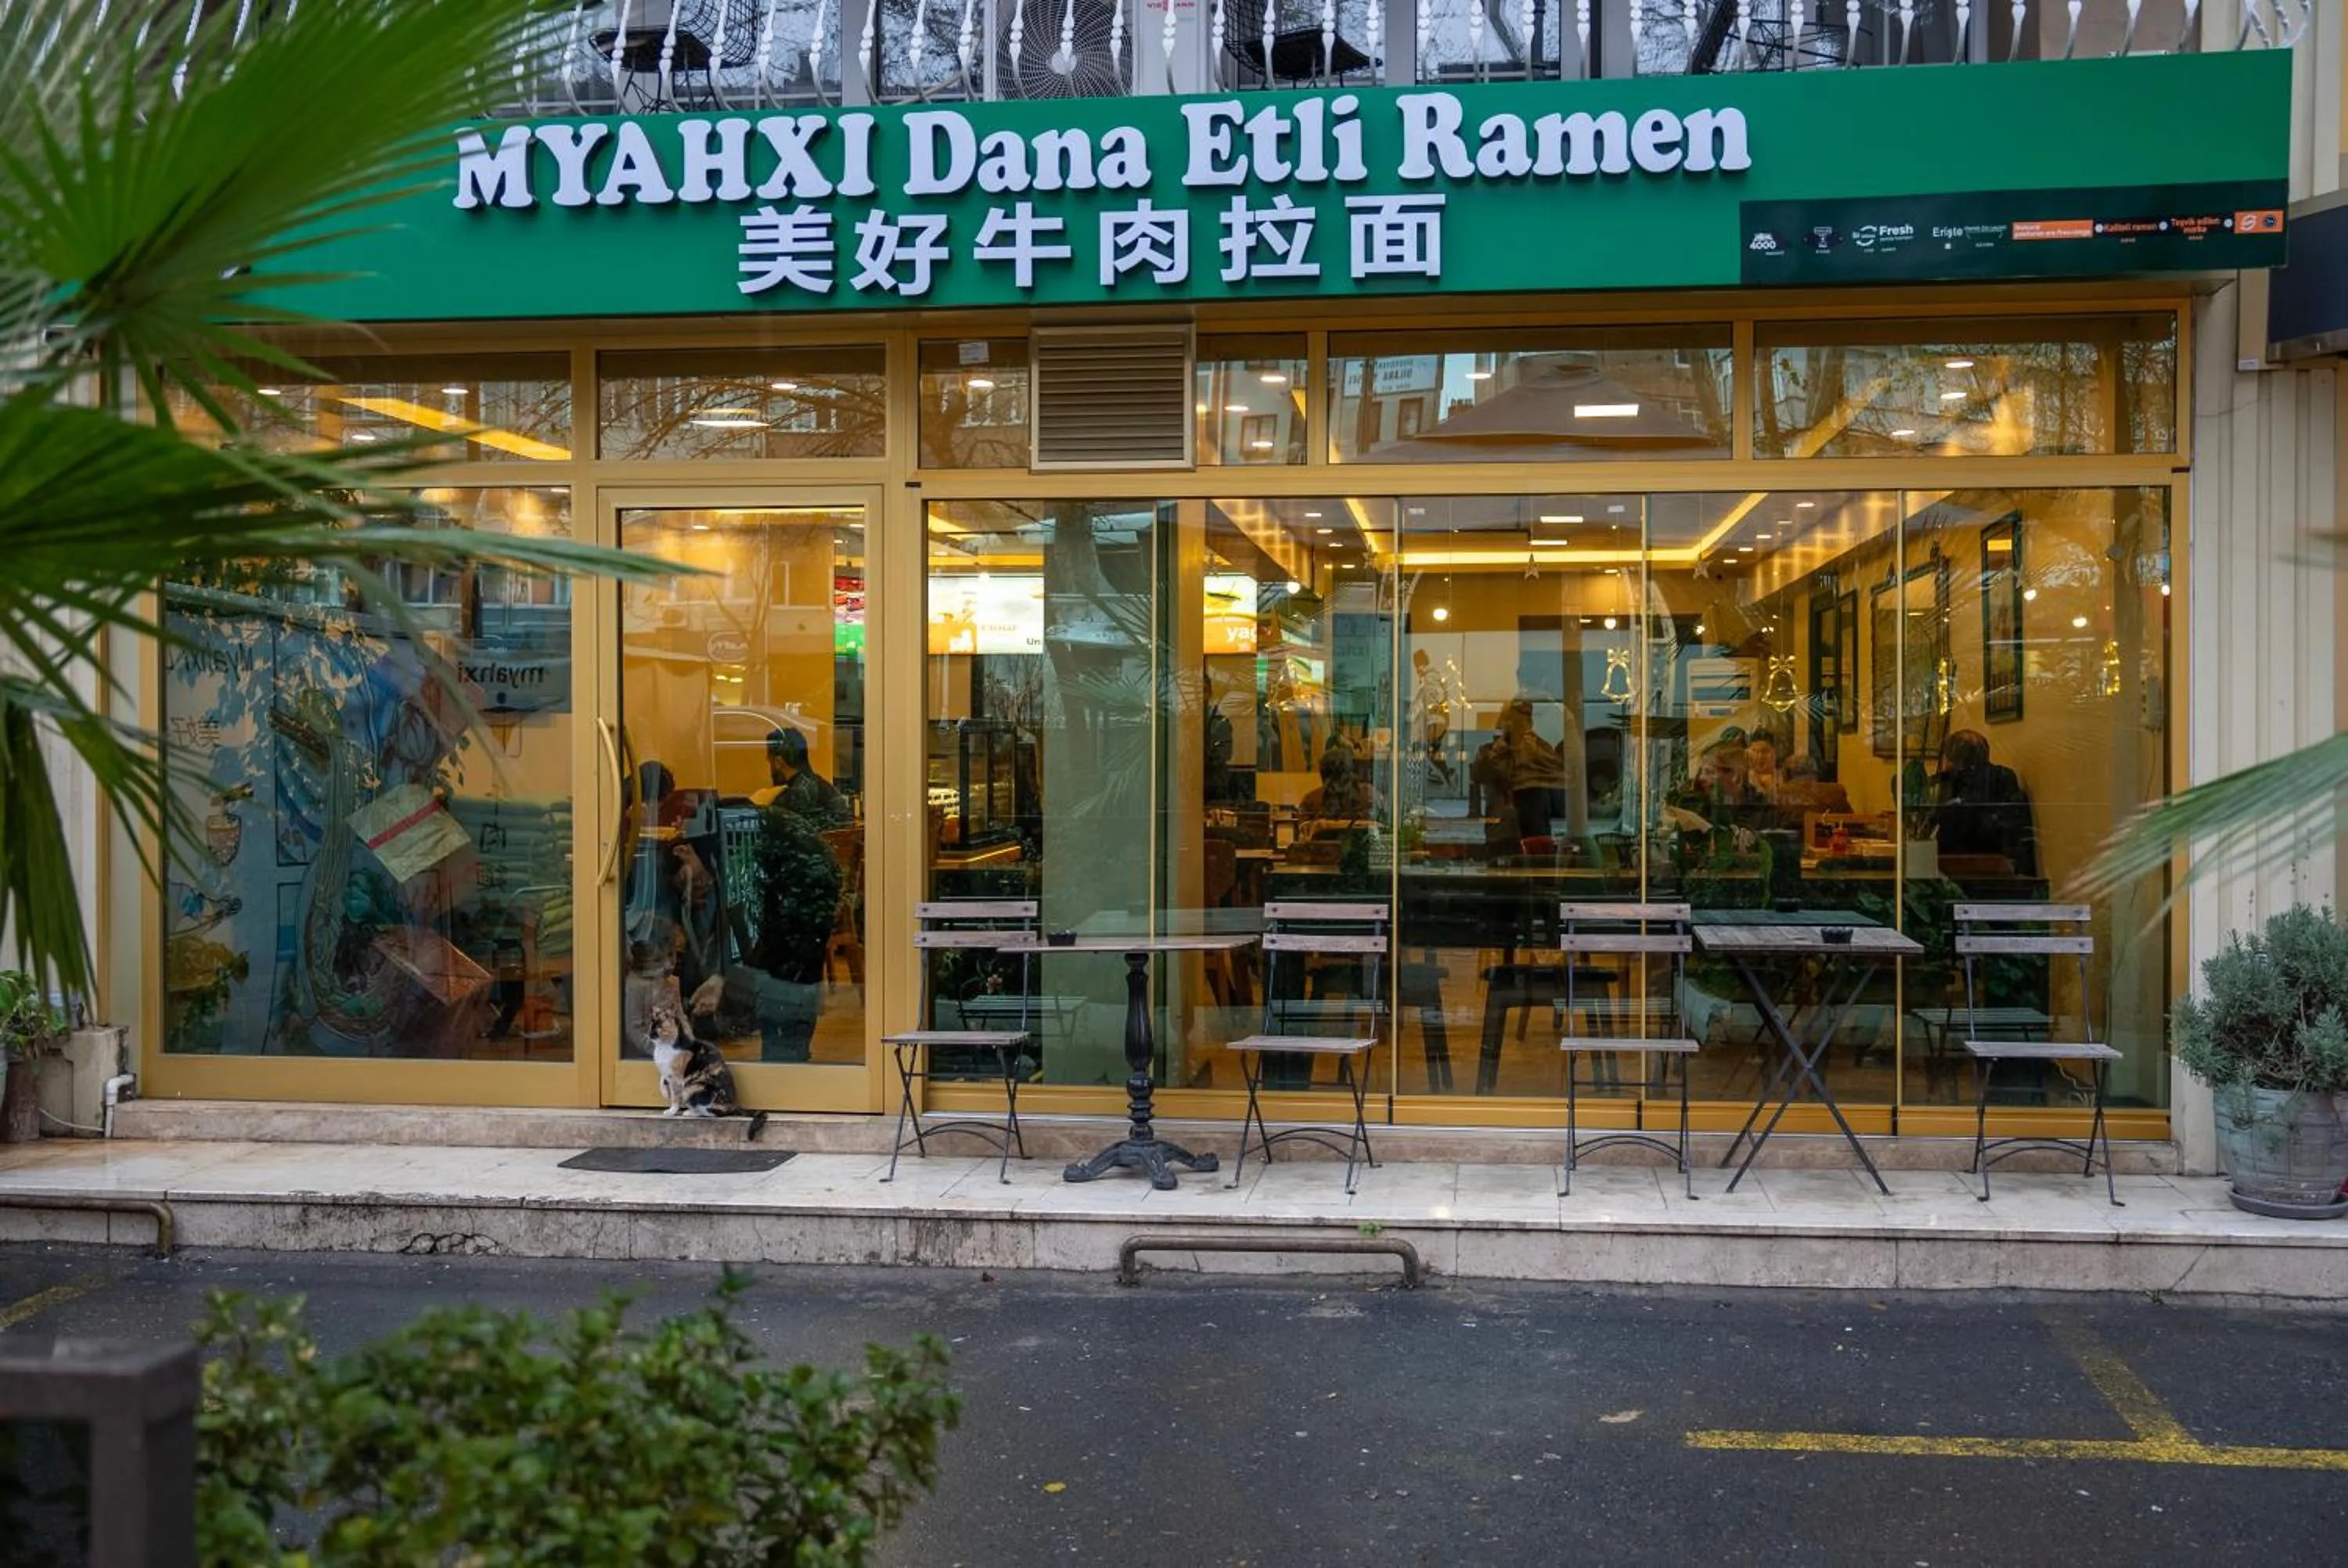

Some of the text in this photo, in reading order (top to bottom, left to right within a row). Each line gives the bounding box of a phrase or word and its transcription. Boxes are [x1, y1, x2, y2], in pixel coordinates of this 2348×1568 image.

[452, 92, 1752, 210] MYAHXI Dana Etli Ramen
[737, 193, 1446, 297] 美好牛肉拉面
[1749, 240, 1776, 250] 4000
[1879, 224, 1914, 236] Fresh
